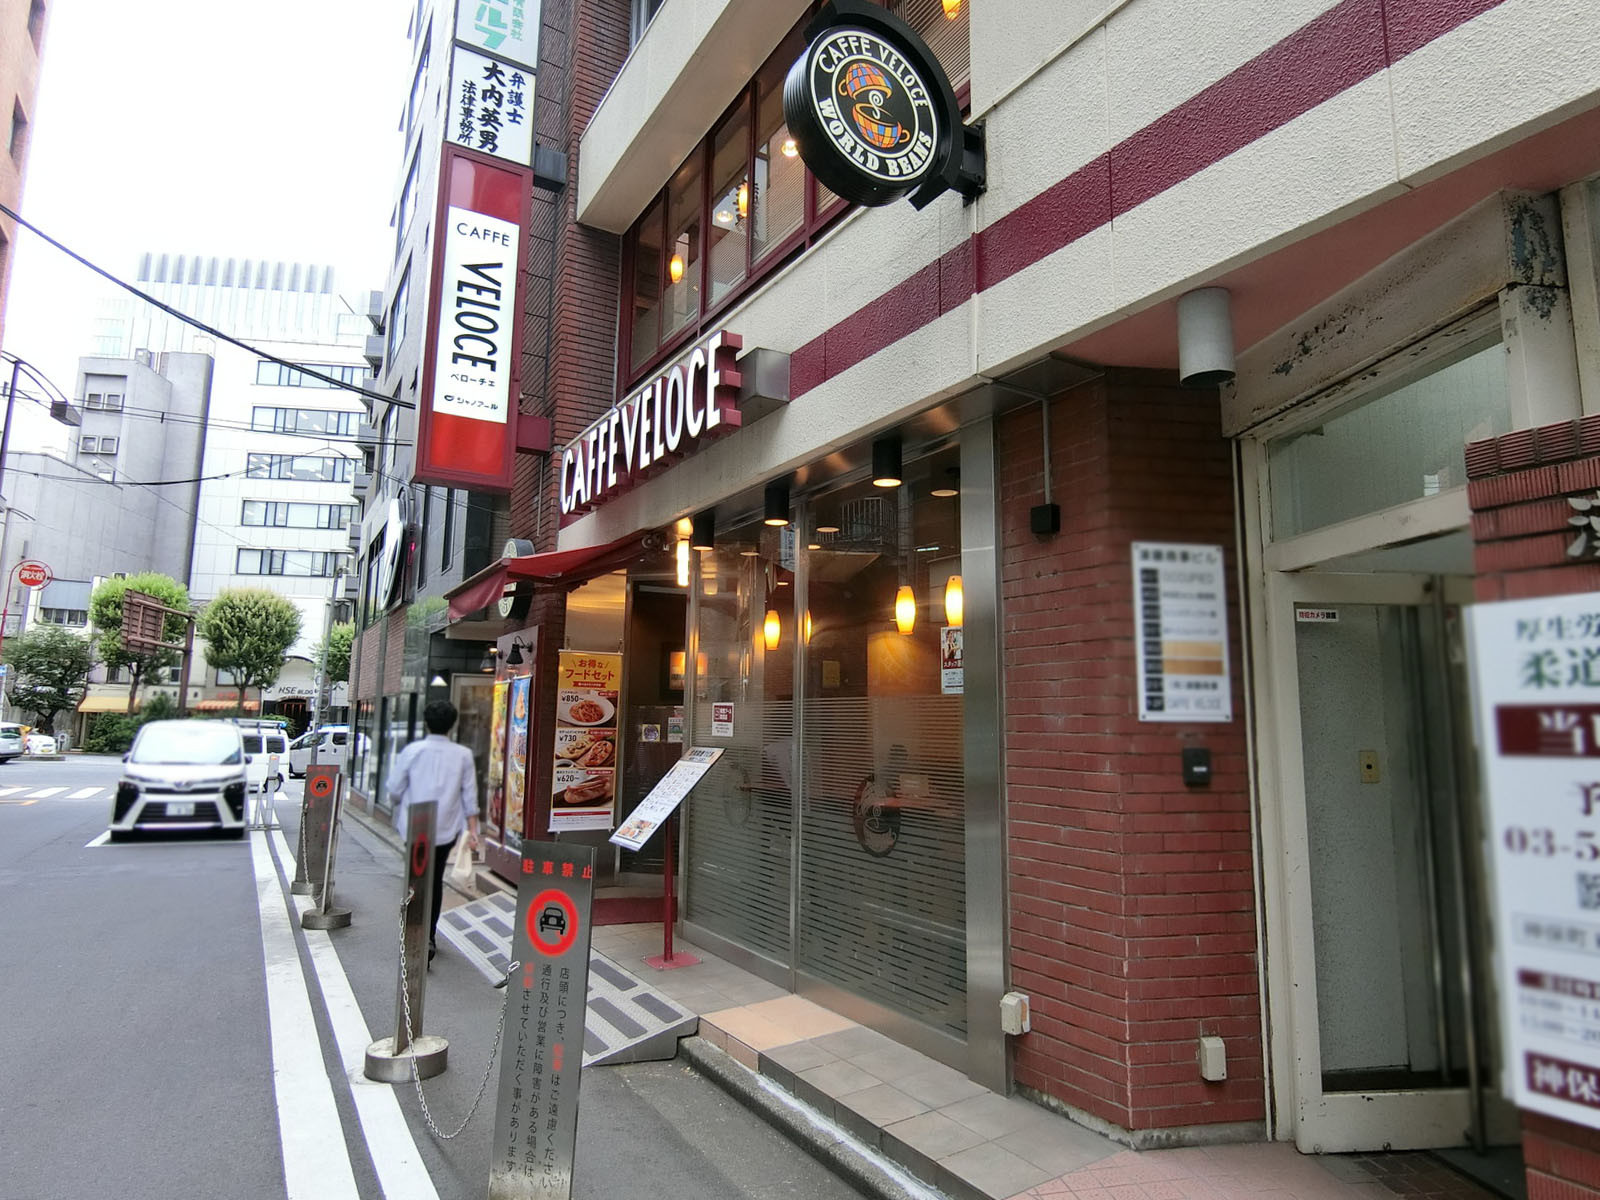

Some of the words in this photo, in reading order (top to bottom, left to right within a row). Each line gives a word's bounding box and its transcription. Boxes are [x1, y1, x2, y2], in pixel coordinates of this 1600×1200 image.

[477, 61, 507, 153] 大内英男
[505, 72, 526, 126] 弁護士
[878, 45, 929, 108] VELOCE
[457, 80, 477, 146] 法律事務所
[818, 97, 880, 172] WORLD
[884, 131, 932, 176] BEANS
[452, 262, 503, 372] VELOCE
[620, 329, 727, 479] VELOCE
[565, 668, 615, 681] フードセット
[578, 659, 604, 668] お得な
[522, 858, 592, 879] 駐車禁止
[506, 961, 535, 1180] させていただく事があります。
[541, 967, 571, 1198] 店頭につき、はご遠慮ください。
